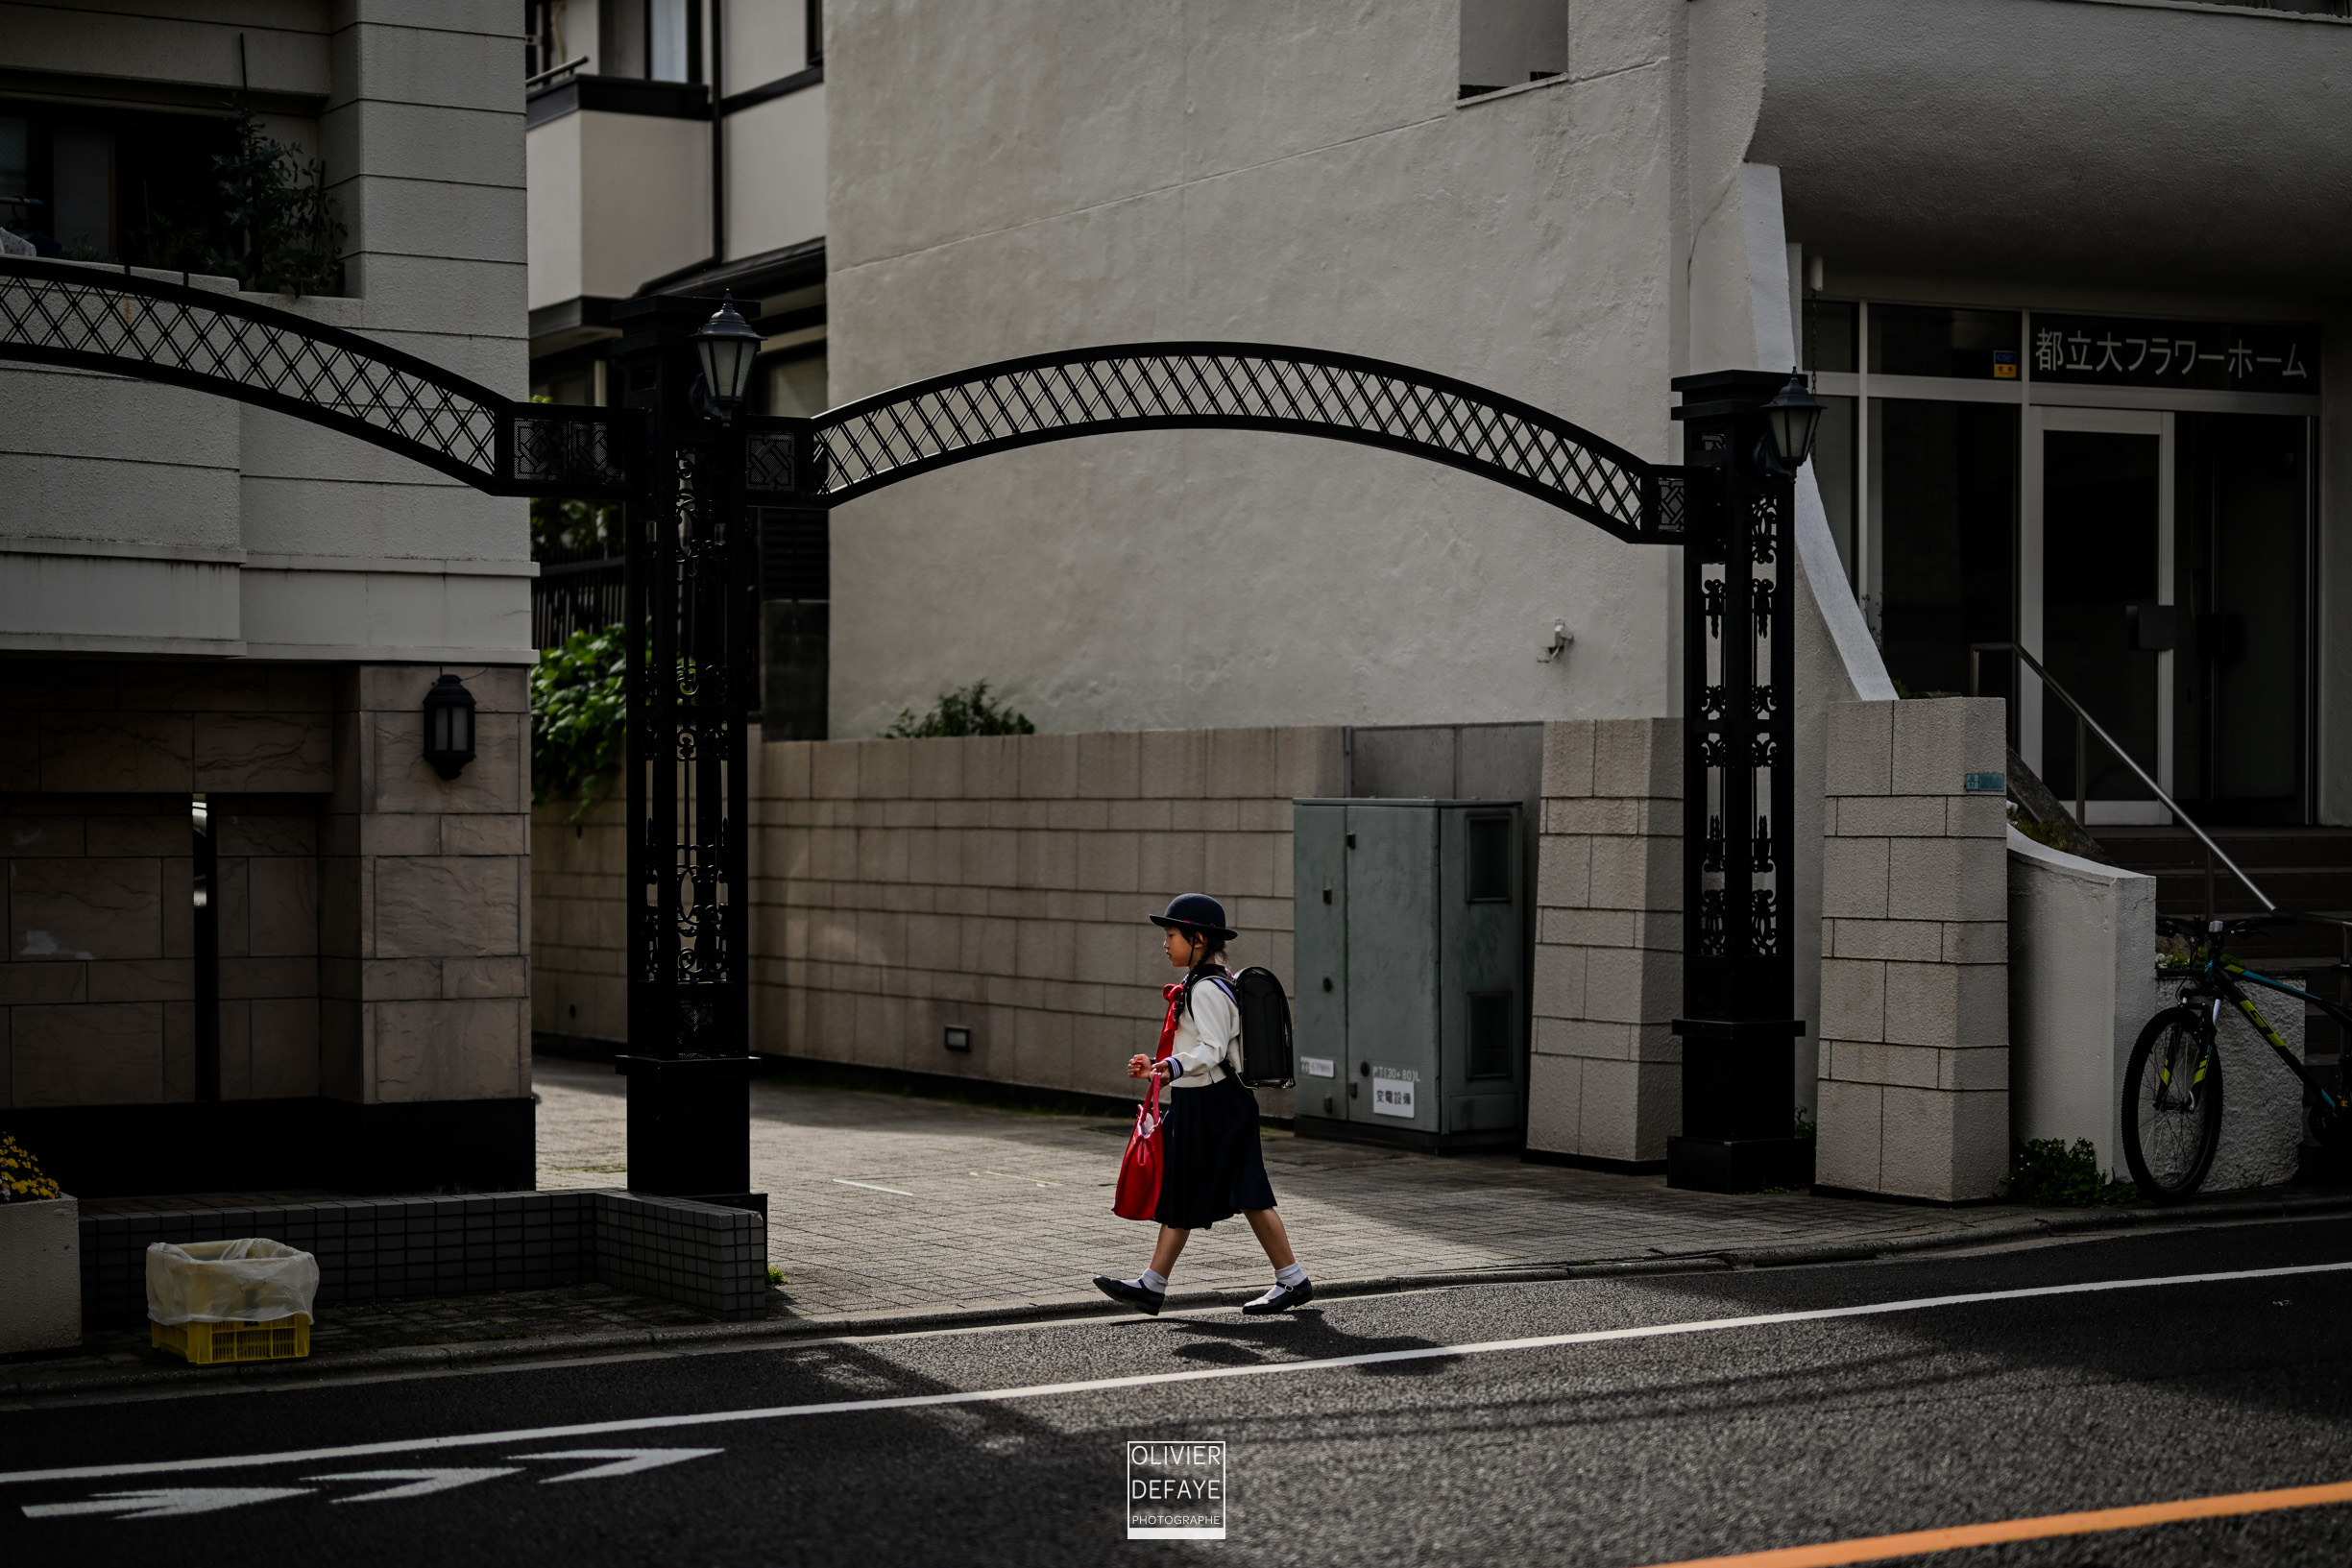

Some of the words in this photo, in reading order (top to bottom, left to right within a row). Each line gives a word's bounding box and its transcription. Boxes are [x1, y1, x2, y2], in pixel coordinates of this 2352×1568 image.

[2035, 326, 2307, 379] 都立大フラワーホーム
[1376, 1090, 1412, 1105] 変電設備
